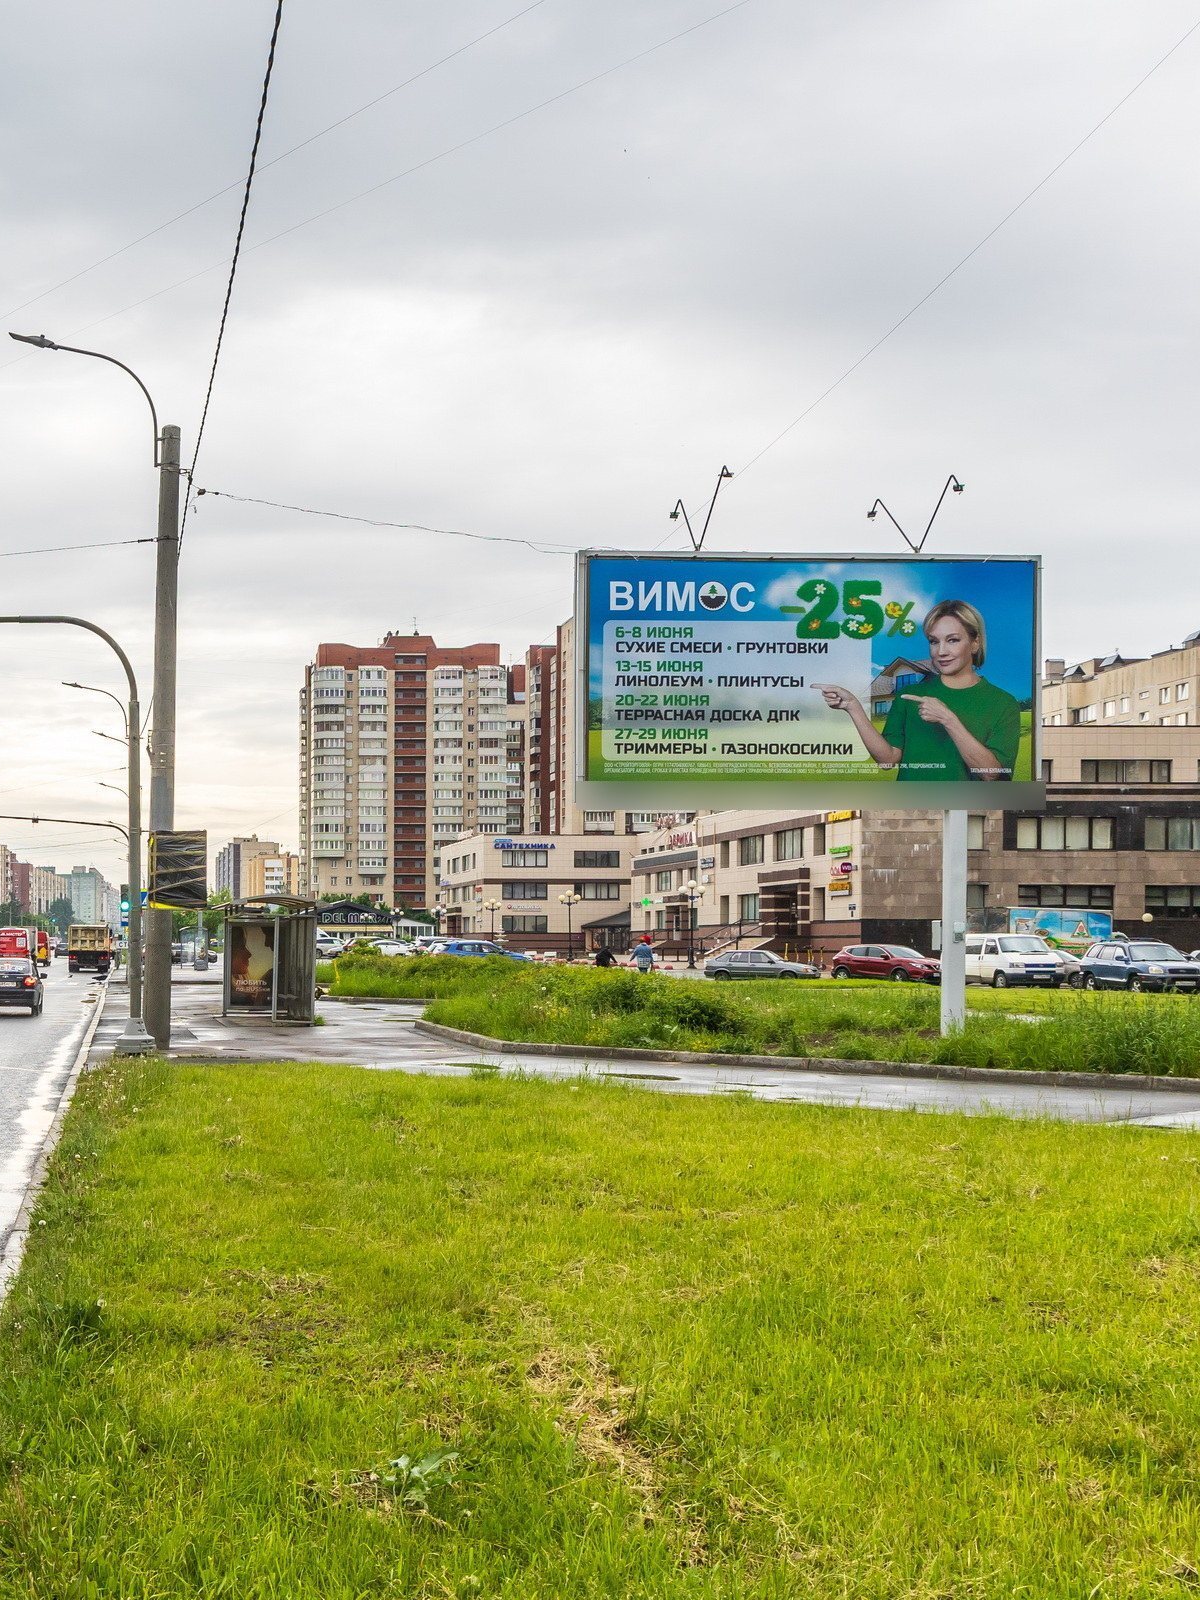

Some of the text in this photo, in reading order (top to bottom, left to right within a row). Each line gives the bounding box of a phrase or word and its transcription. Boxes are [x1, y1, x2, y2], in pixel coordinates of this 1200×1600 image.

[609, 580, 756, 613] ВИМОС
[779, 578, 917, 640] -25%
[615, 626, 694, 639] 6-8 ИЮНЯ
[615, 641, 829, 654] СУХИЕ СМЕСИ ГРУНТОВКИ
[615, 660, 704, 673] 13-15 ИЮНЯ
[614, 675, 804, 688] ЛИНОЛЕУМ ПЛИНТУСЫ
[615, 694, 710, 707] 20-22 ИЮНЯ
[614, 709, 801, 723] ТЕРРАСНАЯ ДОСКА ДПК
[614, 728, 708, 740] 27-29 ИЮНЯ
[614, 743, 854, 756] ТРИММЕРЫ ГАЗОНОКОСИЛКИ
[494, 842, 556, 850] САНТЕХНИКА
[322, 912, 346, 924] DEL
